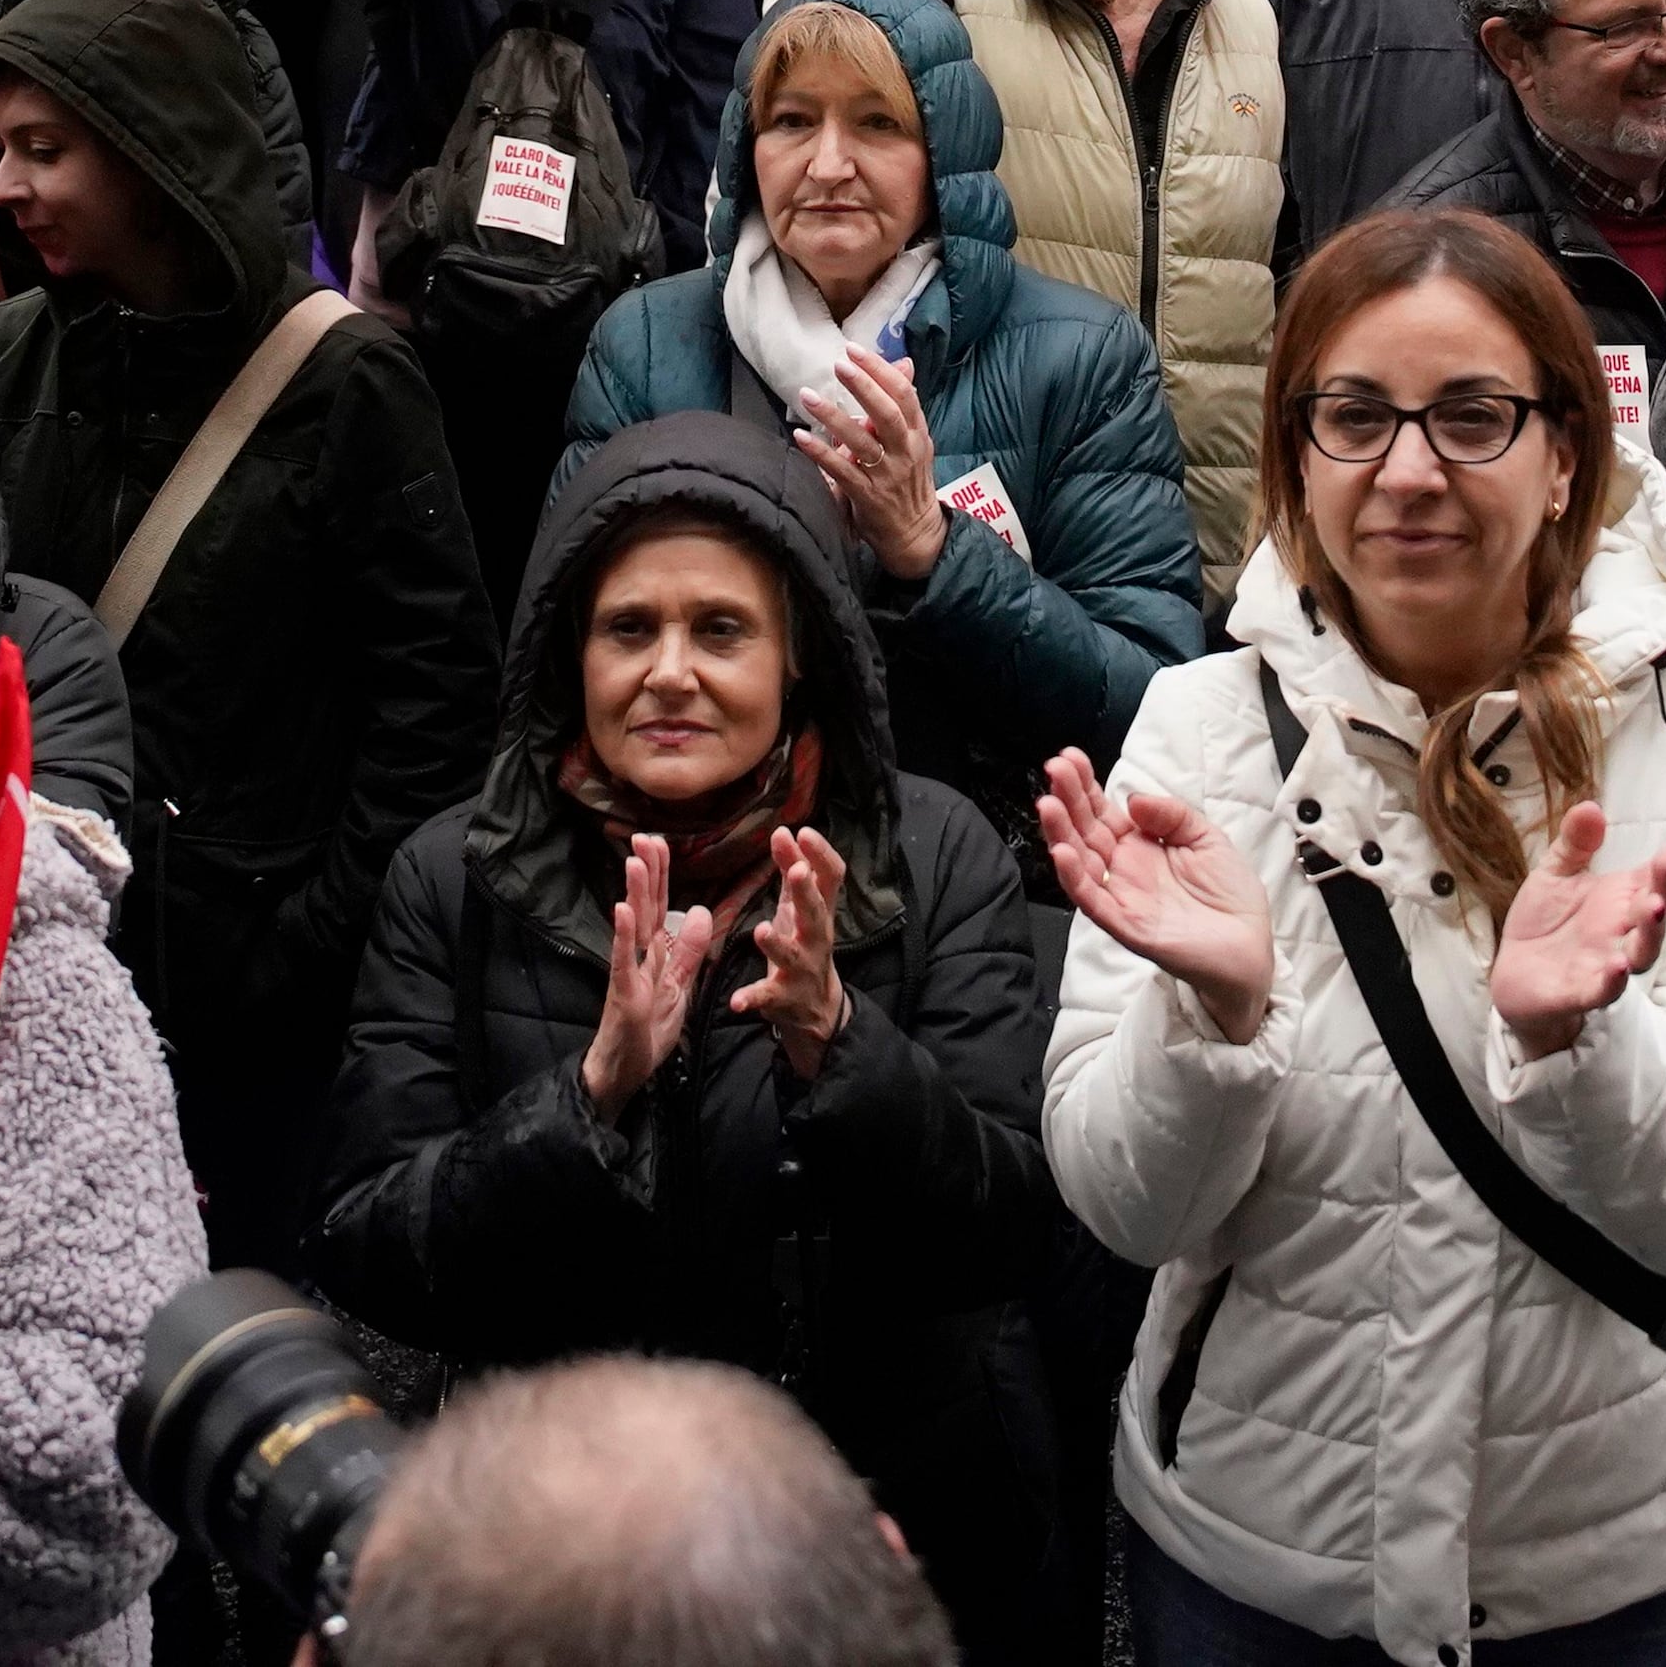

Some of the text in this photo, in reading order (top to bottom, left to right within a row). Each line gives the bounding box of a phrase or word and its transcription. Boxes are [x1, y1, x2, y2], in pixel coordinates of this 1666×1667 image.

[505, 144, 563, 172] CLARO QUE
[494, 160, 566, 191] VALE LA PENA
[491, 181, 562, 211] ¡QUÉÉÉDATE!
[1603, 354, 1631, 373] QUE
[951, 480, 986, 510] QUE
